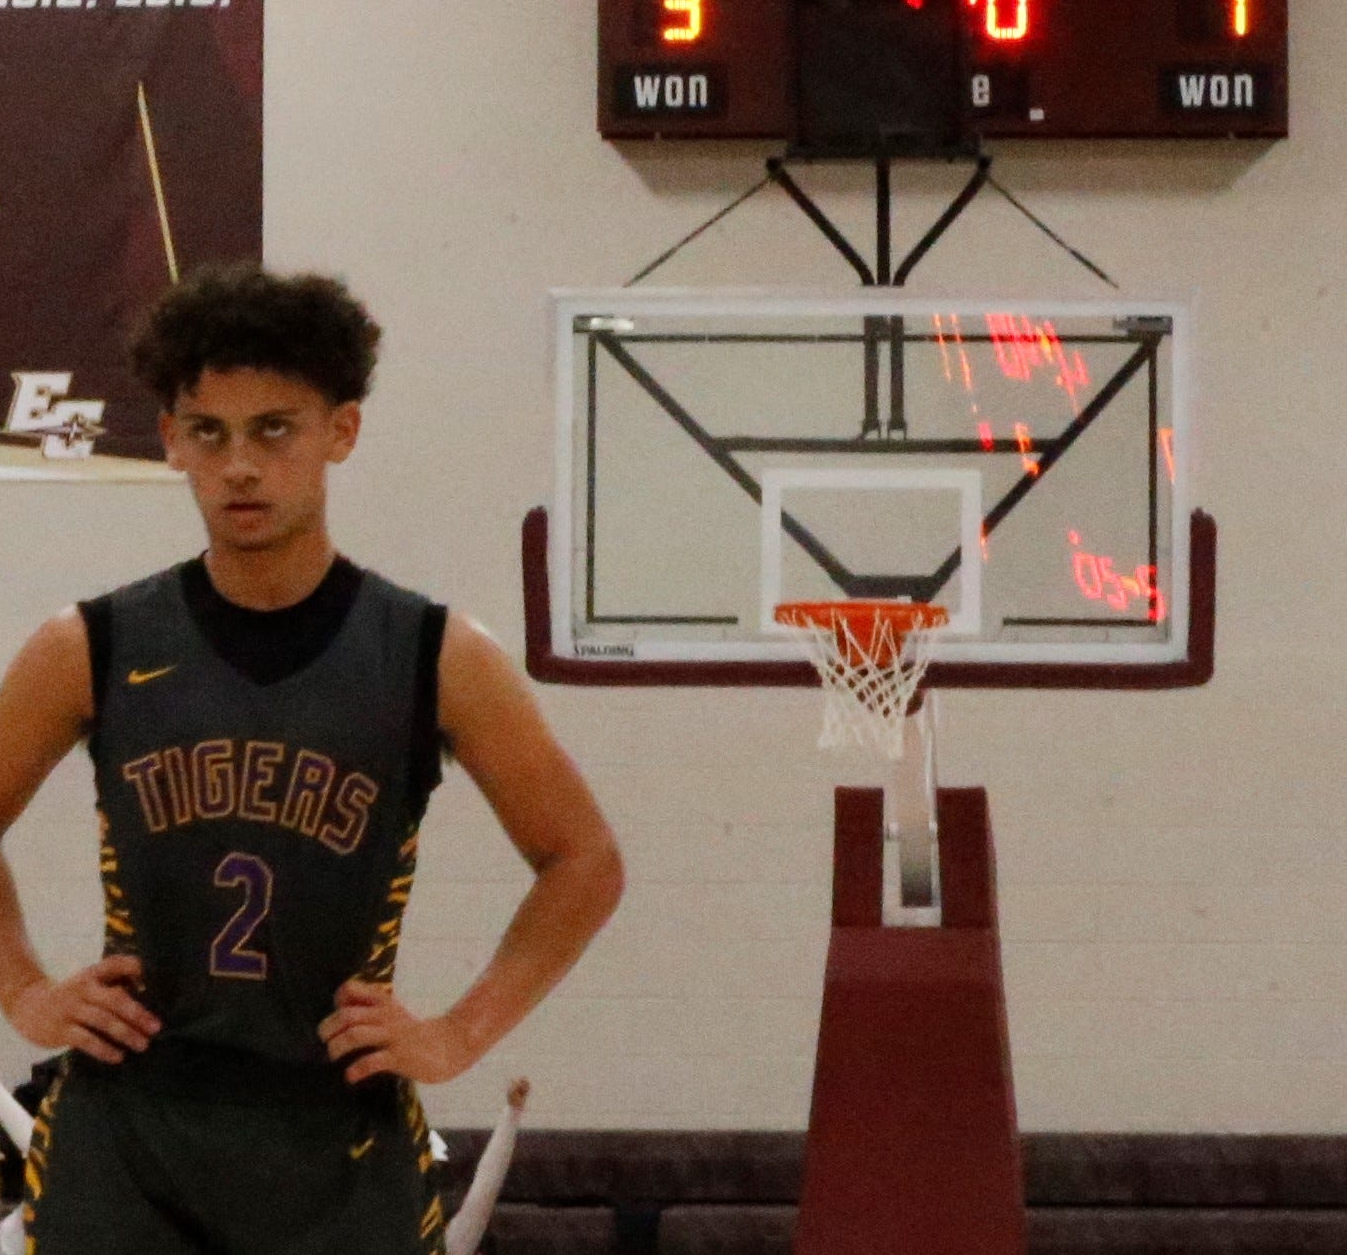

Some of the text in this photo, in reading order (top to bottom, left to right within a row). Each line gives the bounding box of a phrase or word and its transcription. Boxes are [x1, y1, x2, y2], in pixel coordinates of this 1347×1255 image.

[633, 73, 708, 108] won
[1178, 73, 1254, 108] won
[122, 738, 380, 855] TIGERS
[209, 851, 274, 981] 2
